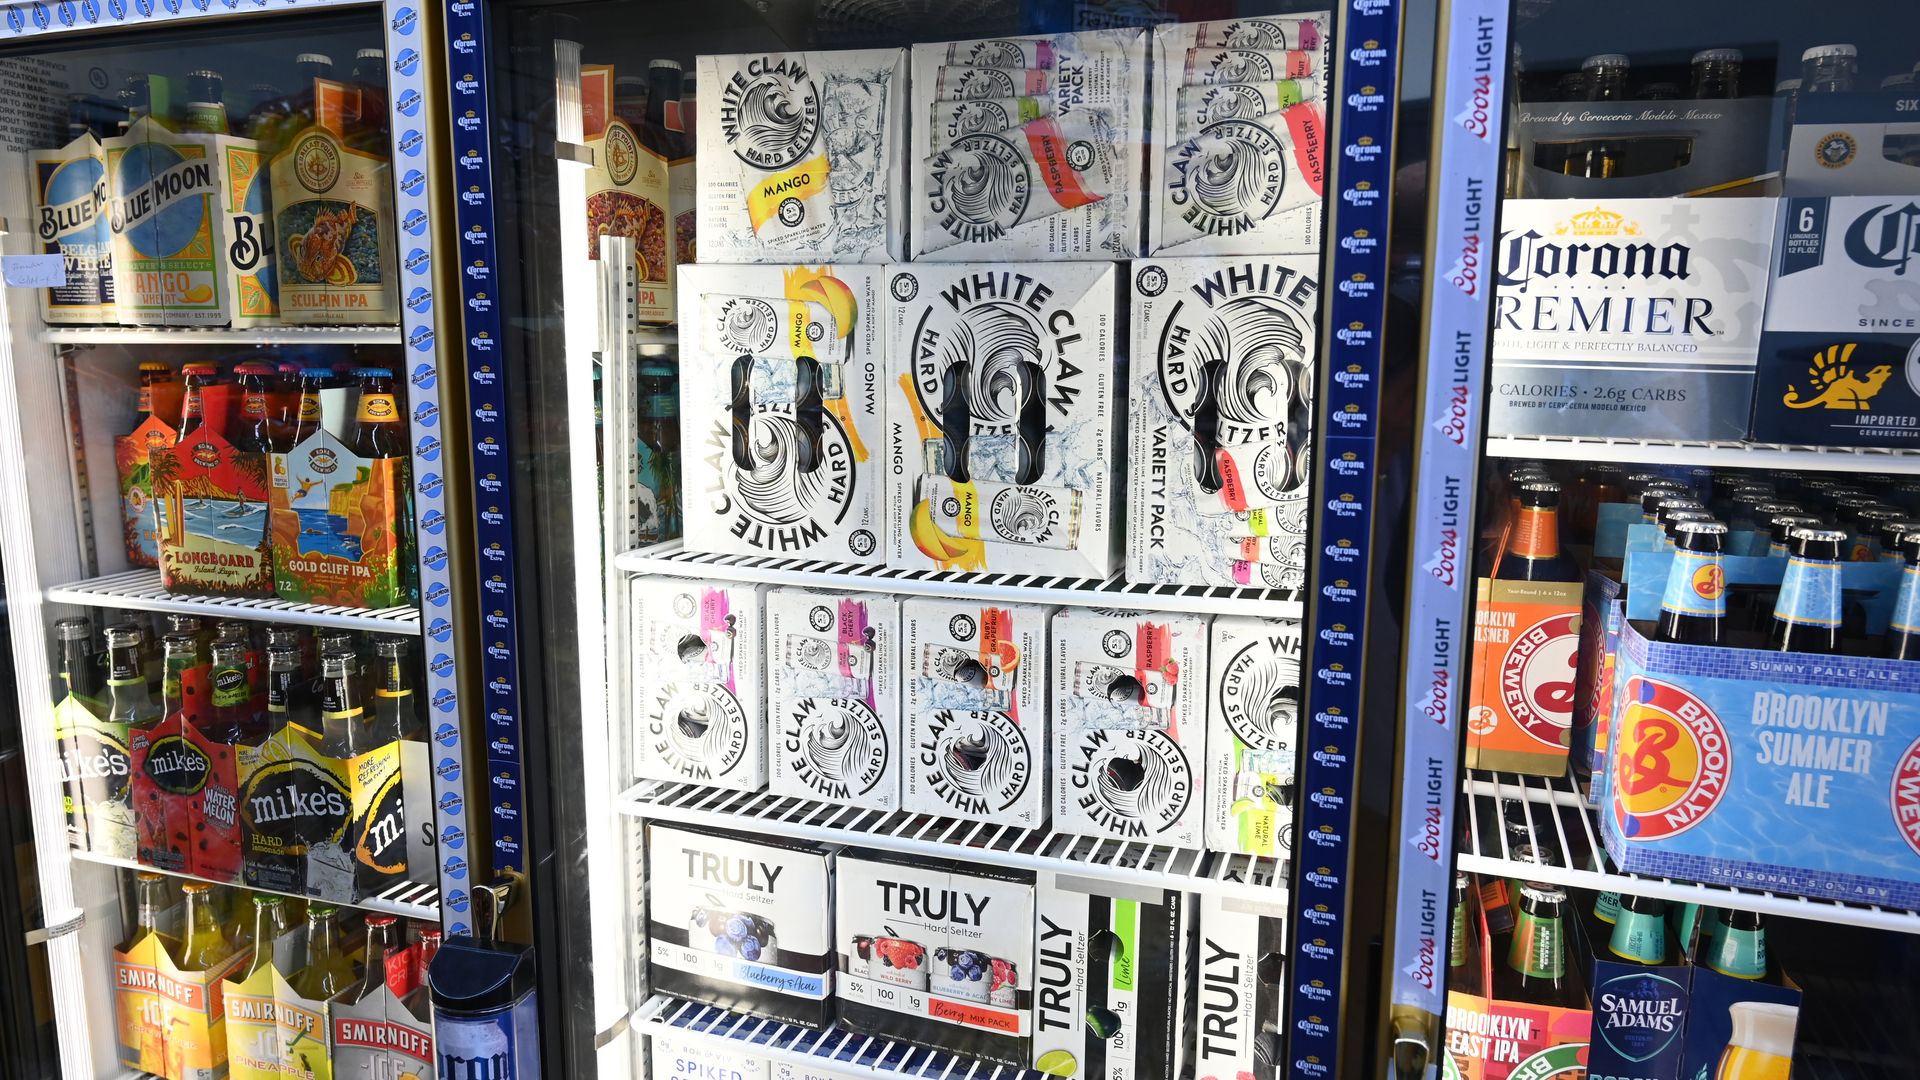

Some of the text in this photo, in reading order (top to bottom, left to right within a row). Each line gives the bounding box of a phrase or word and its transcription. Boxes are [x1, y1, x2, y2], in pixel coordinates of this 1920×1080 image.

[1351, 48, 1387, 60] Corona
[1360, 57, 1380, 66] Extra
[1059, 54, 1072, 117] VARIETY
[1072, 65, 1084, 104] PACK
[1464, 16, 1494, 140] Coors LIGHT
[721, 56, 809, 144] WHITE CLAW
[1520, 110, 1723, 126] Brewed by Cerveceria Modelo Mexico
[1896, 99, 1919, 112] SIX
[746, 95, 816, 164] HARD SELTZER
[460, 156, 483, 166] Corona
[1041, 135, 1064, 194] RASPBERRY
[1214, 127, 1279, 206] HARD SELTZER
[1302, 120, 1323, 183] RASPBERRY
[764, 174, 810, 198] MANGO
[963, 140, 1025, 215] HARD SELTZER
[1169, 137, 1256, 236] WHITE CLAW
[112, 164, 210, 233] BLUE MOON
[928, 151, 1005, 243] WHITE CLAW
[39, 199, 92, 240] BLUE
[1799, 207, 1814, 232] 6
[1497, 228, 1692, 294] Corona
[291, 294, 368, 307] SCULPIN IPA
[1190, 263, 1318, 308] WHITE
[795, 313, 803, 347] MANGO
[1494, 295, 1713, 336] REMIER
[1858, 318, 1915, 328] SINCE
[921, 328, 940, 395] HARD
[941, 272, 1084, 416] WHITE CLAW
[1167, 325, 1190, 395] HARD
[1574, 341, 1698, 353] PERFECTLY BALANCED
[865, 362, 875, 415] MANGO
[1500, 383, 1686, 402] CALORIES 2.6g CARBS
[1855, 414, 1917, 426] IMPORTED
[1859, 430, 1919, 438] CERVECERIA
[893, 423, 903, 474] MANGO
[704, 419, 829, 550] WHITE CLAW
[827, 443, 846, 504] HARD
[1151, 426, 1167, 549] VARIETY PACK
[1432, 476, 1460, 587] Coors LIGHT
[175, 551, 254, 568] LONGBOARD
[194, 565, 216, 574] Island
[289, 560, 370, 577] GOLD CLIFF IPA
[217, 672, 243, 687] mike's
[1505, 627, 1548, 728] BREWERY
[1750, 661, 1900, 680] SUNNY PALE ALE
[1227, 655, 1287, 750] HARD SELTZER
[1752, 691, 1889, 736] BROOKLYN
[786, 697, 850, 799] WHITE CLAW
[831, 699, 883, 785] HARD SELTZER
[921, 709, 955, 766] CLAW
[971, 710, 1025, 800] HARD SELTZER
[1756, 730, 1873, 775] SUMMER
[152, 751, 205, 775] mike's
[359, 756, 375, 770] MORE
[493, 776, 516, 785] Corona
[1126, 729, 1185, 821] HARD SELTZER
[1664, 700, 1724, 830] BROOKLYN
[204, 787, 236, 811] WATER
[926, 771, 990, 815] WHITE
[1071, 728, 1148, 838] WHITE CLAW
[1785, 773, 1833, 809] ALE
[204, 803, 235, 825] MELON
[251, 785, 345, 823] mike's
[1417, 757, 1443, 862] Coors LIGHT
[252, 834, 282, 846] HARD
[682, 848, 783, 894] TRULY
[1306, 871, 1339, 884] Corona
[1314, 881, 1333, 889] Extra
[1711, 866, 1888, 897] SEASONAL 5.0% ABV
[877, 879, 991, 927] TRULY
[924, 922, 983, 939] Hard Seltzer
[740, 967, 790, 992] Blueberry
[1039, 913, 1072, 1032] TRULY
[1076, 931, 1086, 992] Hard Seltzer
[1115, 956, 1132, 986] Lime
[120, 969, 193, 1003] SMIRNOFF
[877, 988, 894, 1000] 100
[1202, 937, 1240, 1060] TRULY
[1601, 994, 1683, 1016] SAMUEL
[232, 1000, 314, 1032] SMIRNOFF
[934, 1002, 1010, 1028] Berry MIX PACK
[1447, 1006, 1530, 1041] BROOKLYN
[1605, 1013, 1674, 1032] ADAMS
[342, 1023, 431, 1057] SMIRNOFF
[1451, 1030, 1519, 1064] EAST IPA
[235, 1056, 315, 1080] PINEAPPLE
